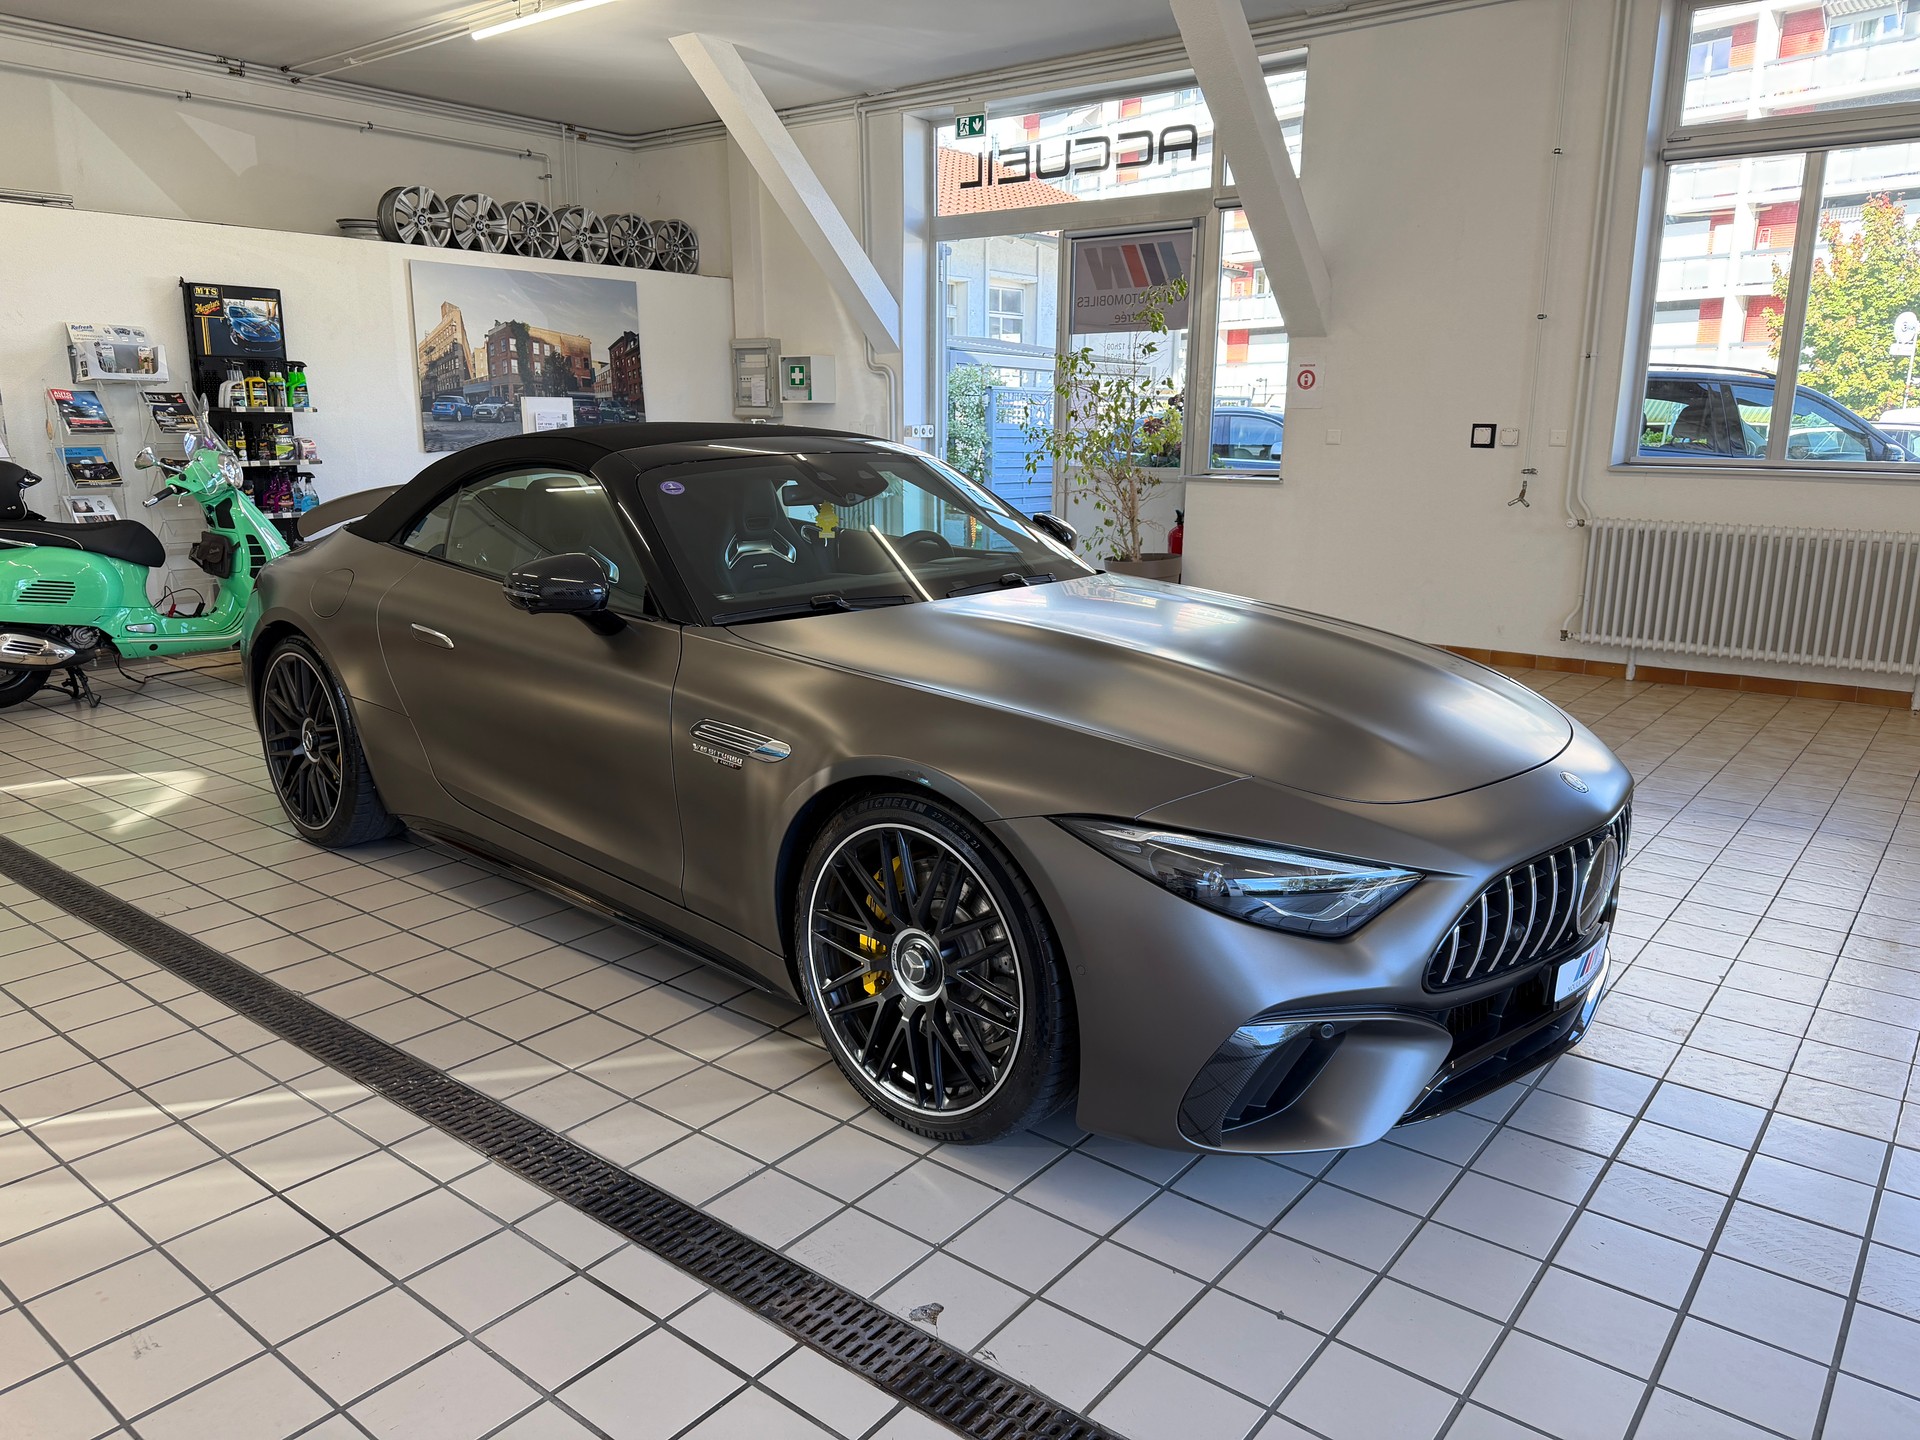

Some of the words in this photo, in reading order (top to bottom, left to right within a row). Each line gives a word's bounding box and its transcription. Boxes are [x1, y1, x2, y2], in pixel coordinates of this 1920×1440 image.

[195, 287, 218, 295] MTS
[858, 797, 928, 814] MICHELIN
[960, 829, 972, 840] ZR
[970, 839, 981, 849] 21
